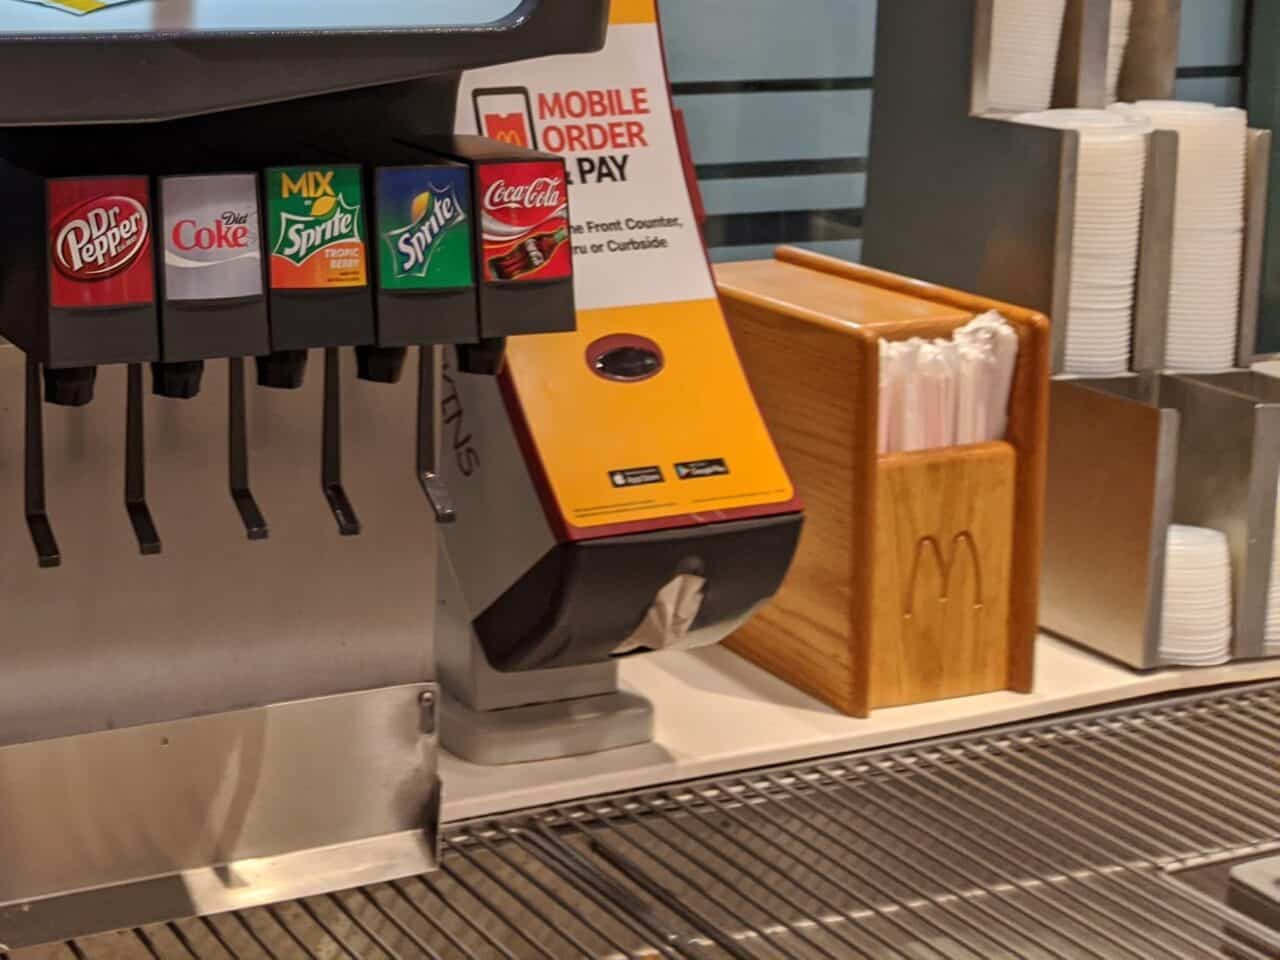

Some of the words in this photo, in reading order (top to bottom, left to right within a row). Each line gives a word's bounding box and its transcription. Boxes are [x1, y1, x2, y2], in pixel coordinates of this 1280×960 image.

[537, 87, 650, 120] MOBILE
[542, 121, 648, 153] ORDER
[280, 170, 335, 198] MIX
[576, 154, 629, 184] PAY
[484, 177, 561, 211] Coca-Cola
[87, 204, 120, 241] Dr
[221, 211, 249, 226] Diet
[283, 208, 352, 257] Sprite
[398, 196, 454, 271] Sprite
[585, 220, 623, 233] Front
[625, 216, 684, 230] Counter,
[65, 211, 141, 273] Pepper
[172, 219, 249, 251] Coke
[590, 243, 604, 254] or
[607, 235, 669, 253] Curbside
